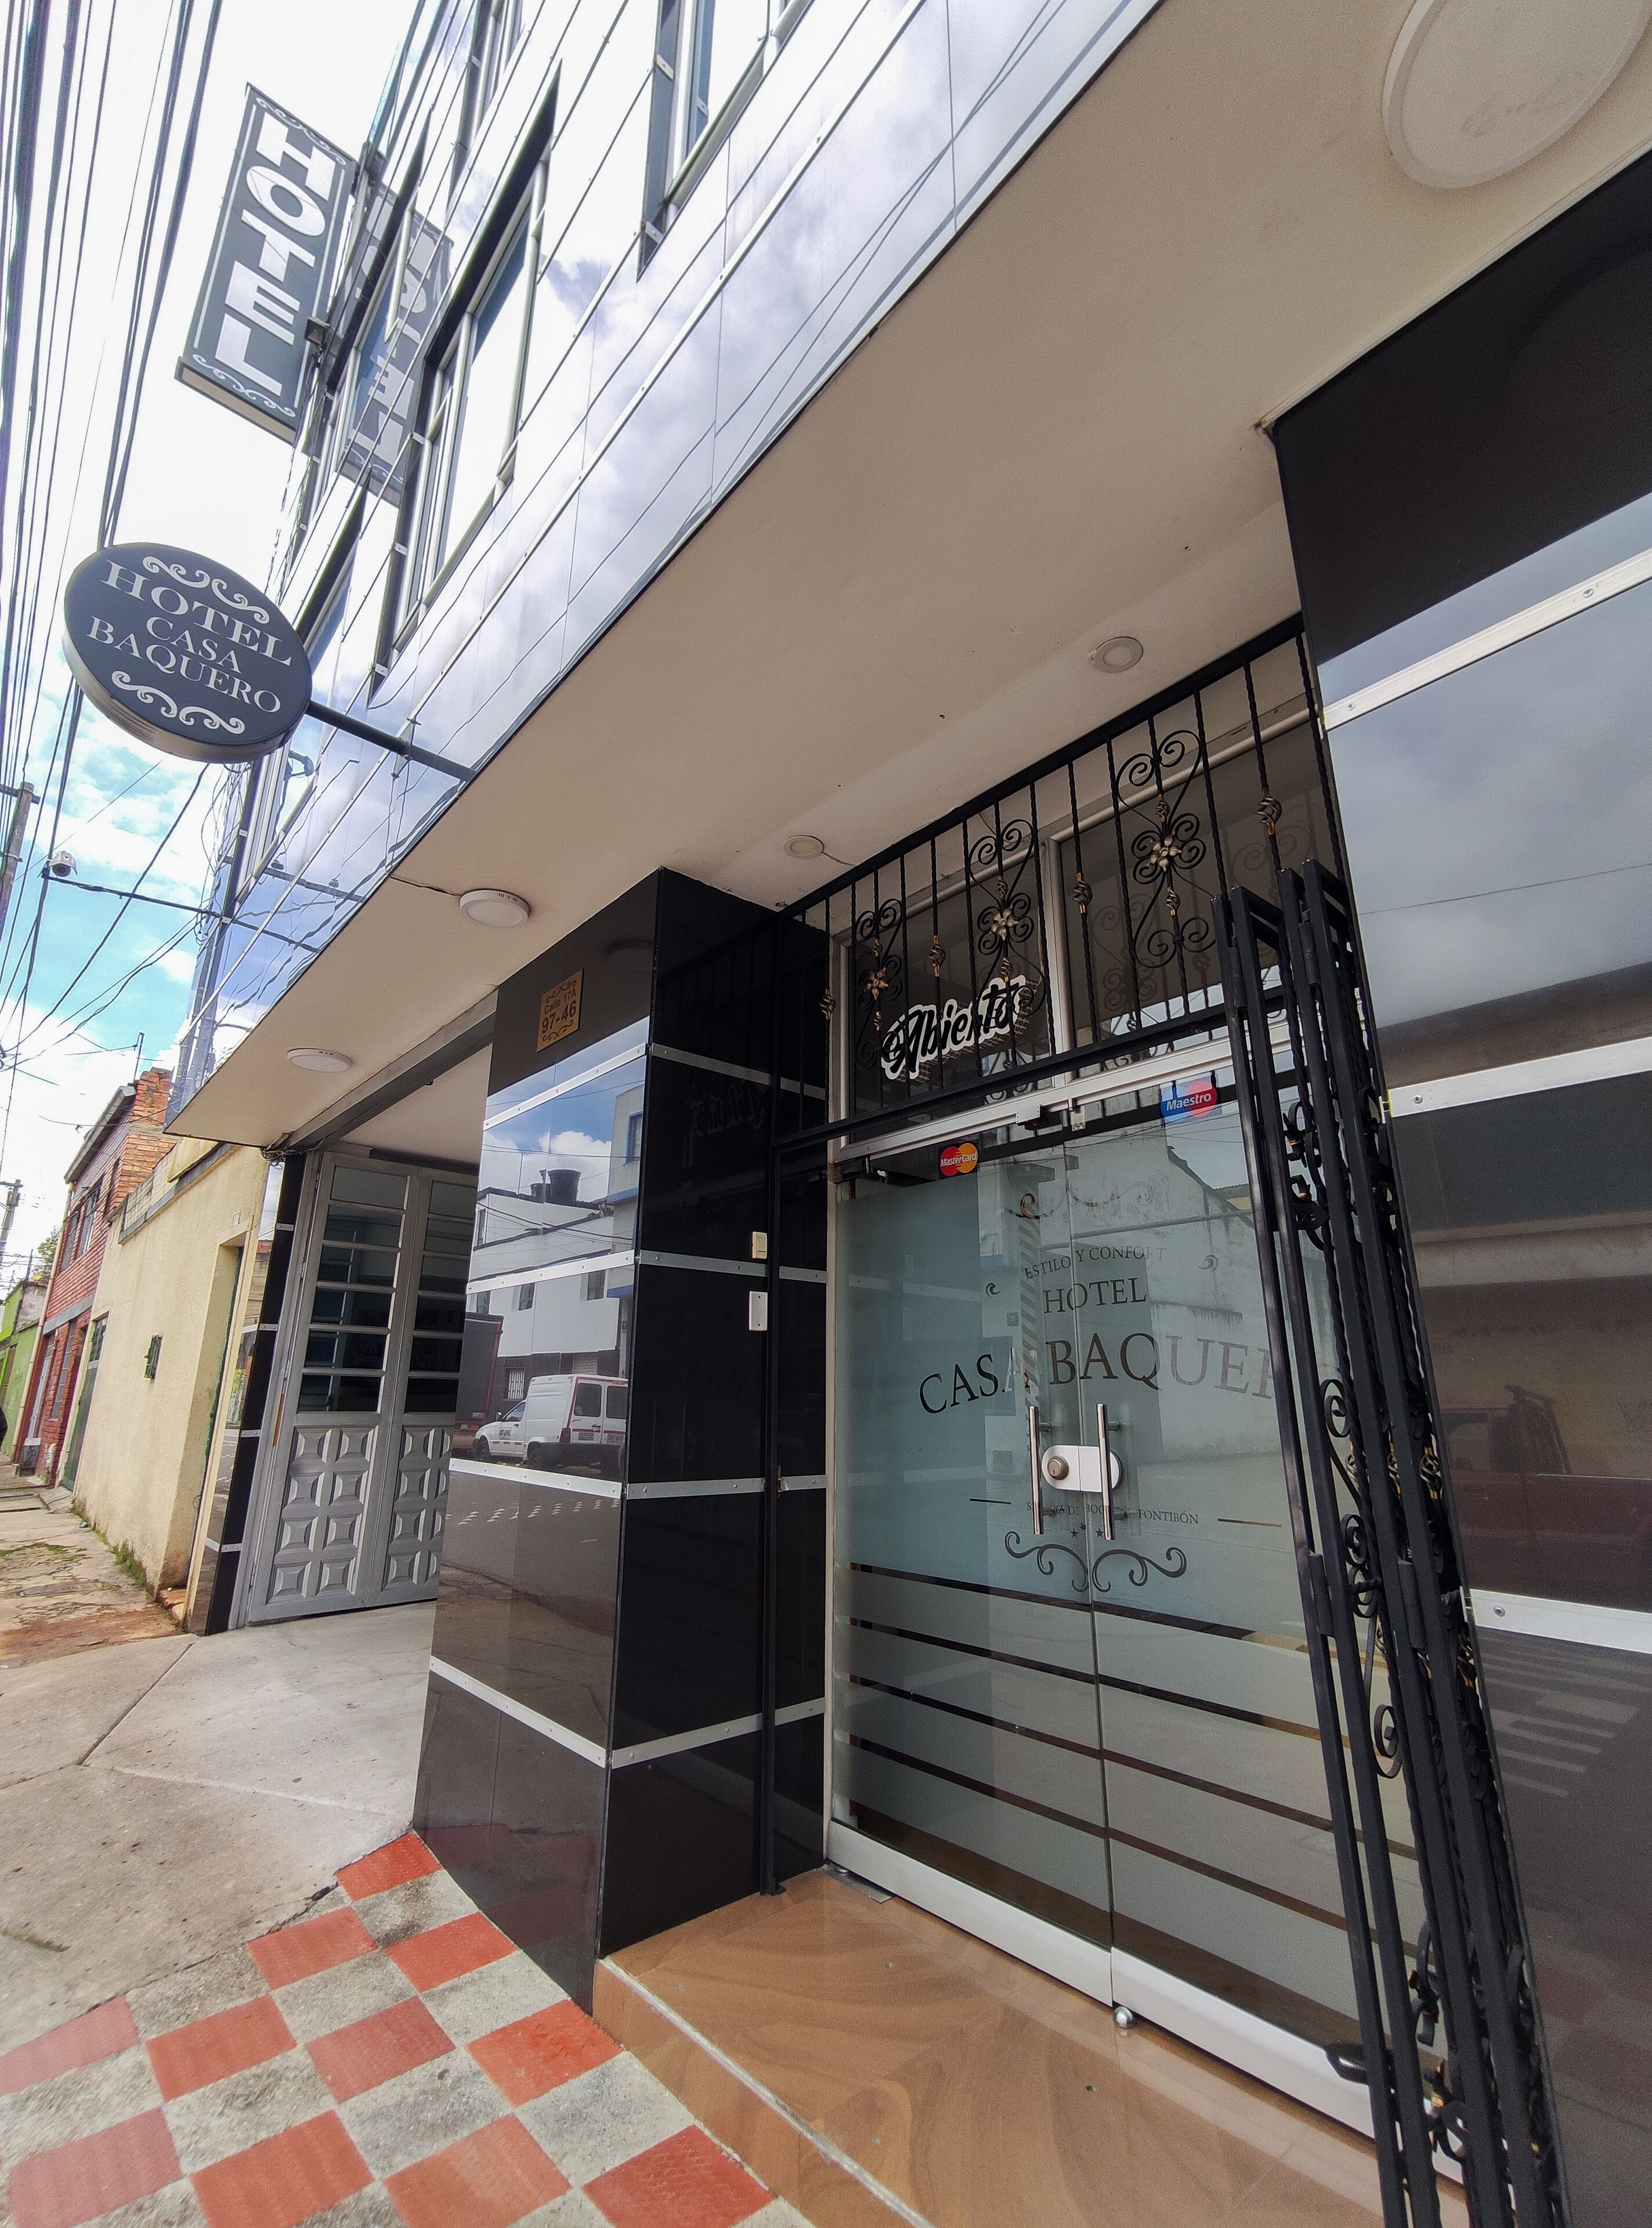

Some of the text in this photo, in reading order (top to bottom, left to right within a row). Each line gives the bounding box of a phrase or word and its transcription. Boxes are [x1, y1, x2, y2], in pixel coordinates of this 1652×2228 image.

[215, 111, 336, 397] HOTEL
[100, 559, 292, 666] HOTEL
[146, 616, 243, 674] CASA
[86, 616, 281, 713] BAQUERO
[541, 1000, 577, 1034] 97-46
[544, 988, 576, 1014] Calle 17A
[881, 976, 1023, 1075] Abierto
[1166, 1093, 1212, 1111] Maestro
[940, 1153, 977, 1167] MasterCard
[1024, 1256, 1071, 1279] ESTILO
[1075, 1249, 1086, 1262] Y
[1043, 1277, 1147, 1314] HOTEL
[1046, 1333, 1273, 1399] BAQUE
[1138, 1509, 1199, 1525] FONTIBÓN
